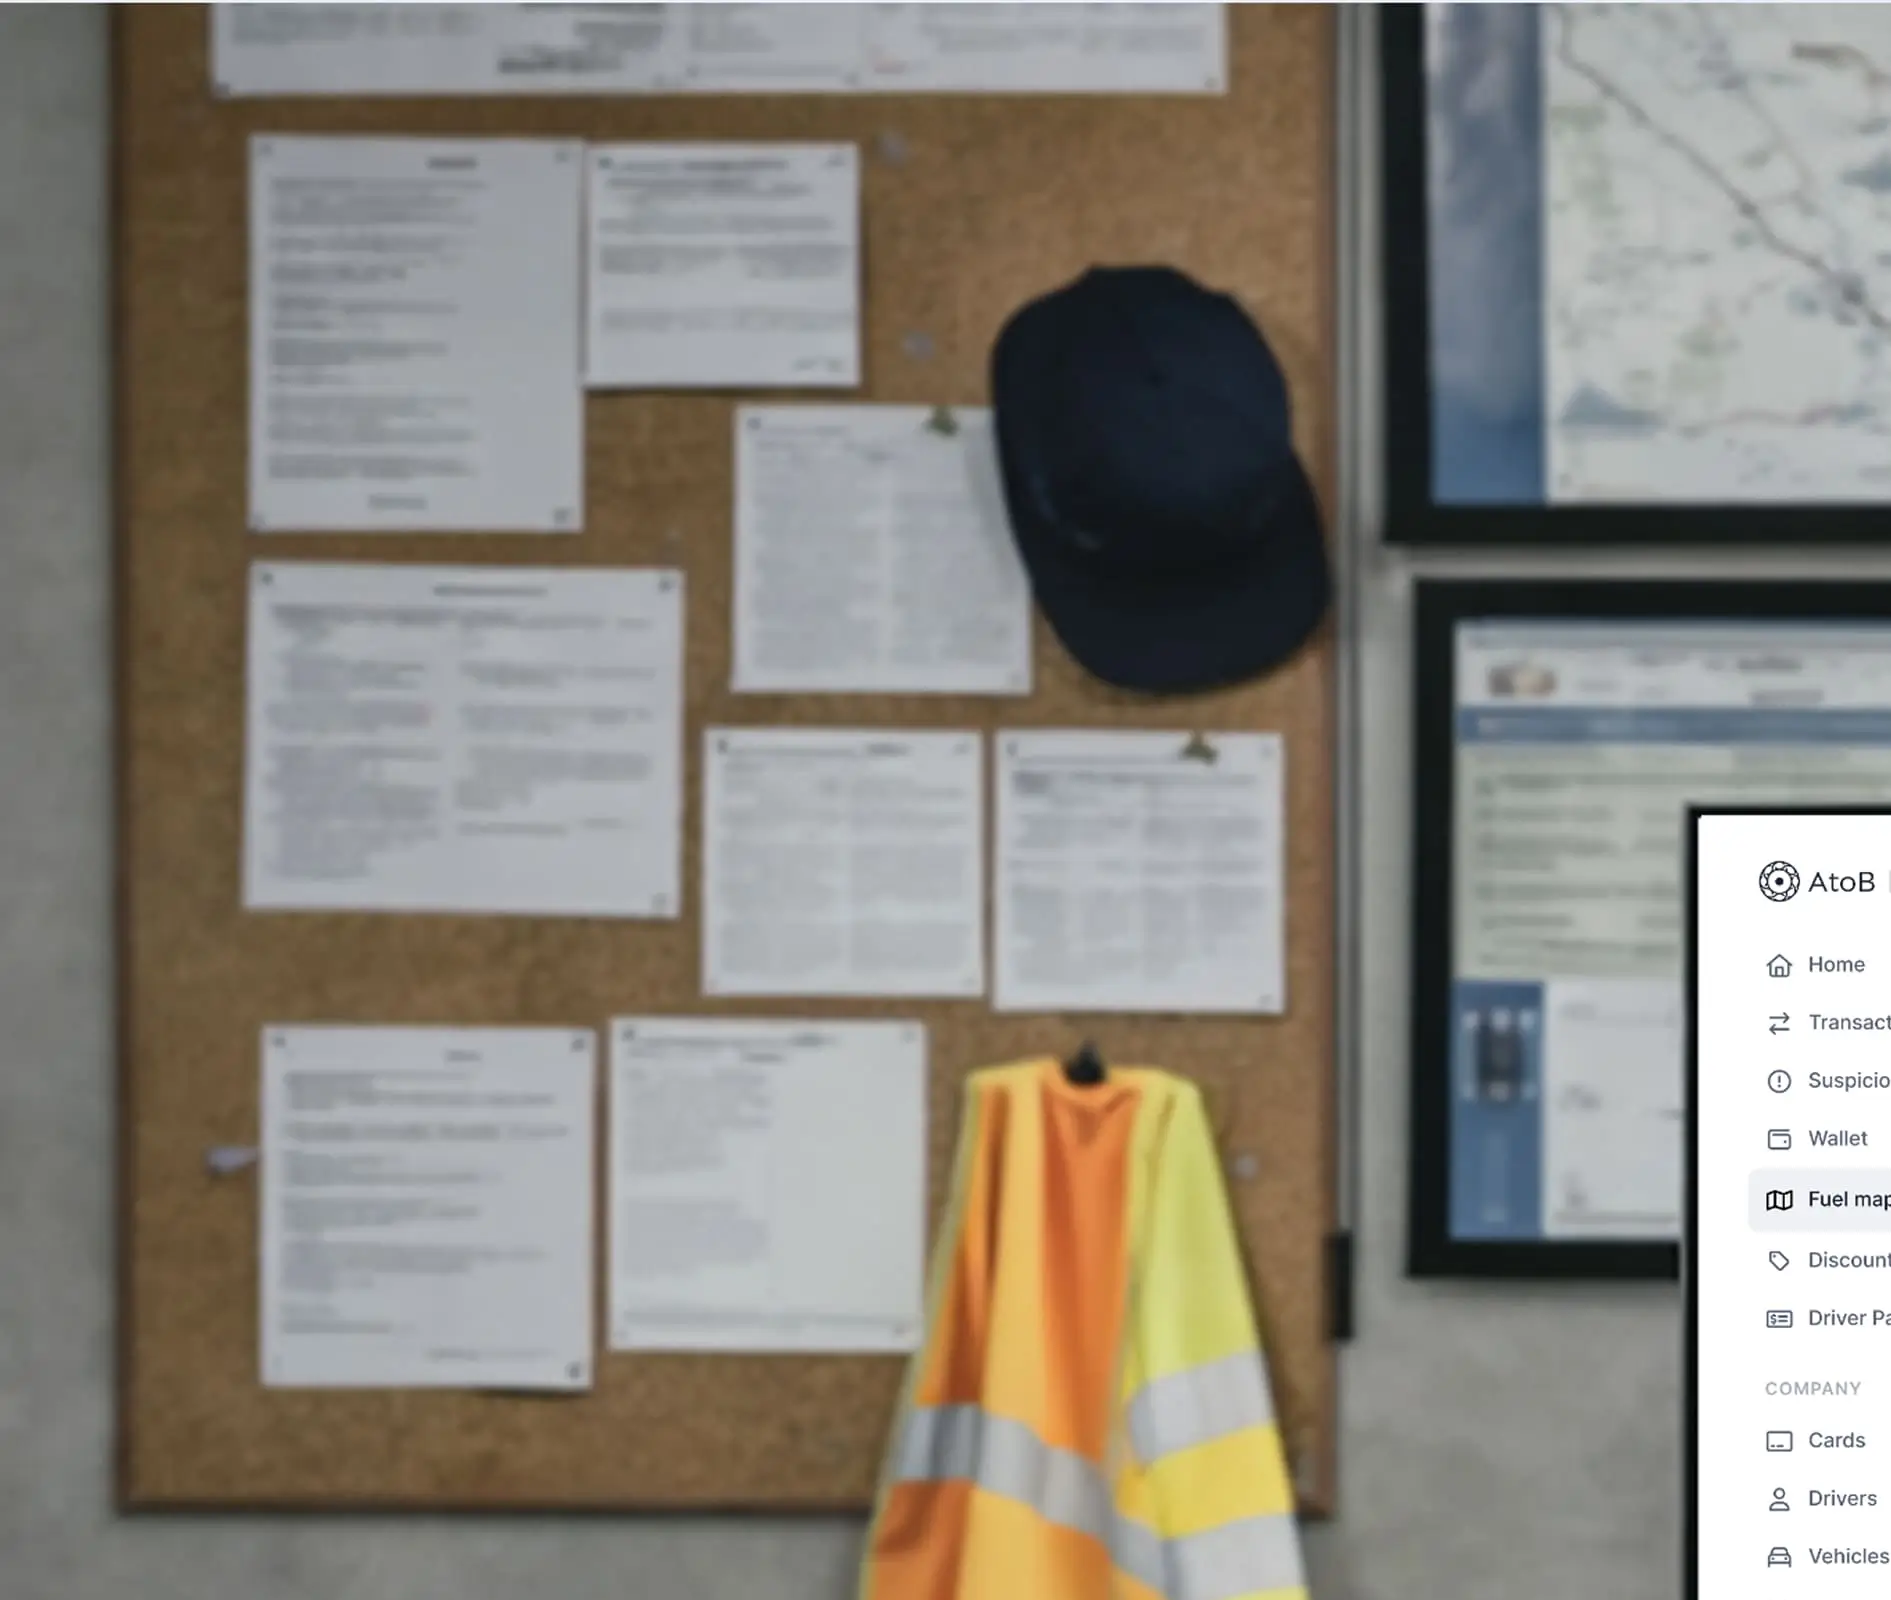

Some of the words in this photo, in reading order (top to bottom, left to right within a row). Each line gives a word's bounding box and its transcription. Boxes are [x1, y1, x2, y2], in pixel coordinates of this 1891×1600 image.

[1807, 871, 1876, 893] AtoB
[1808, 955, 1866, 973] Home
[1808, 1129, 1869, 1147] Wallet
[1808, 1190, 1849, 1208] Fuel
[1808, 1308, 1868, 1326] Driver
[1765, 1381, 1861, 1396] COMPANY
[1808, 1431, 1867, 1449] Cards
[1808, 1489, 1878, 1507] Drivers
[1808, 1547, 1890, 1565] Vehicles
